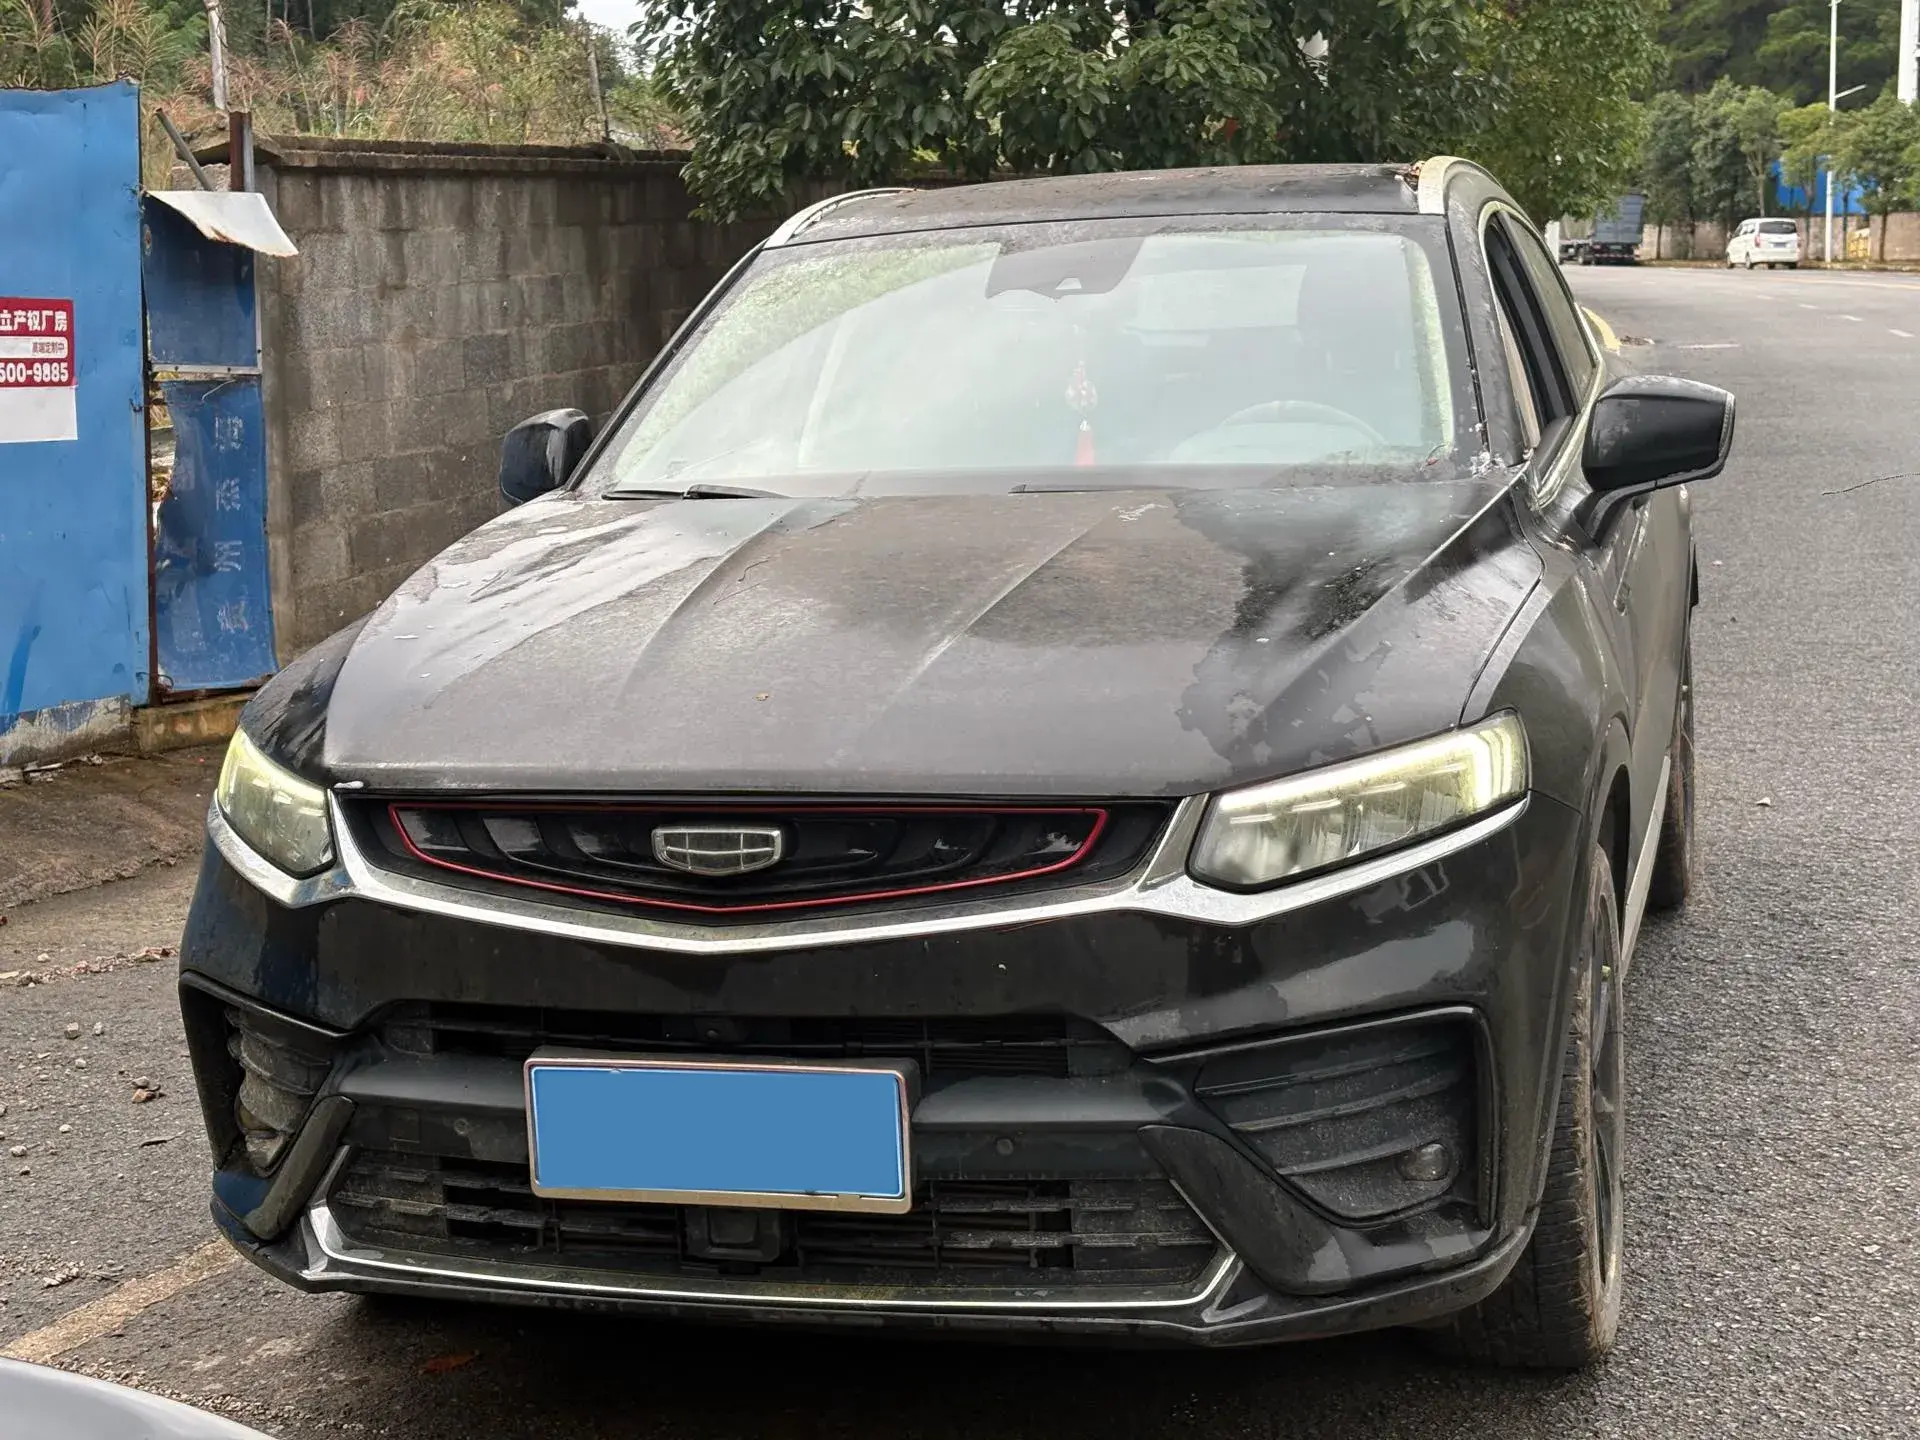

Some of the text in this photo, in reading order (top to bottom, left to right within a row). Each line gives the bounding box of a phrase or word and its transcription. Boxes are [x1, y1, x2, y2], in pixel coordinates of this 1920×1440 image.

[0, 309, 68, 332] 立产权厂房
